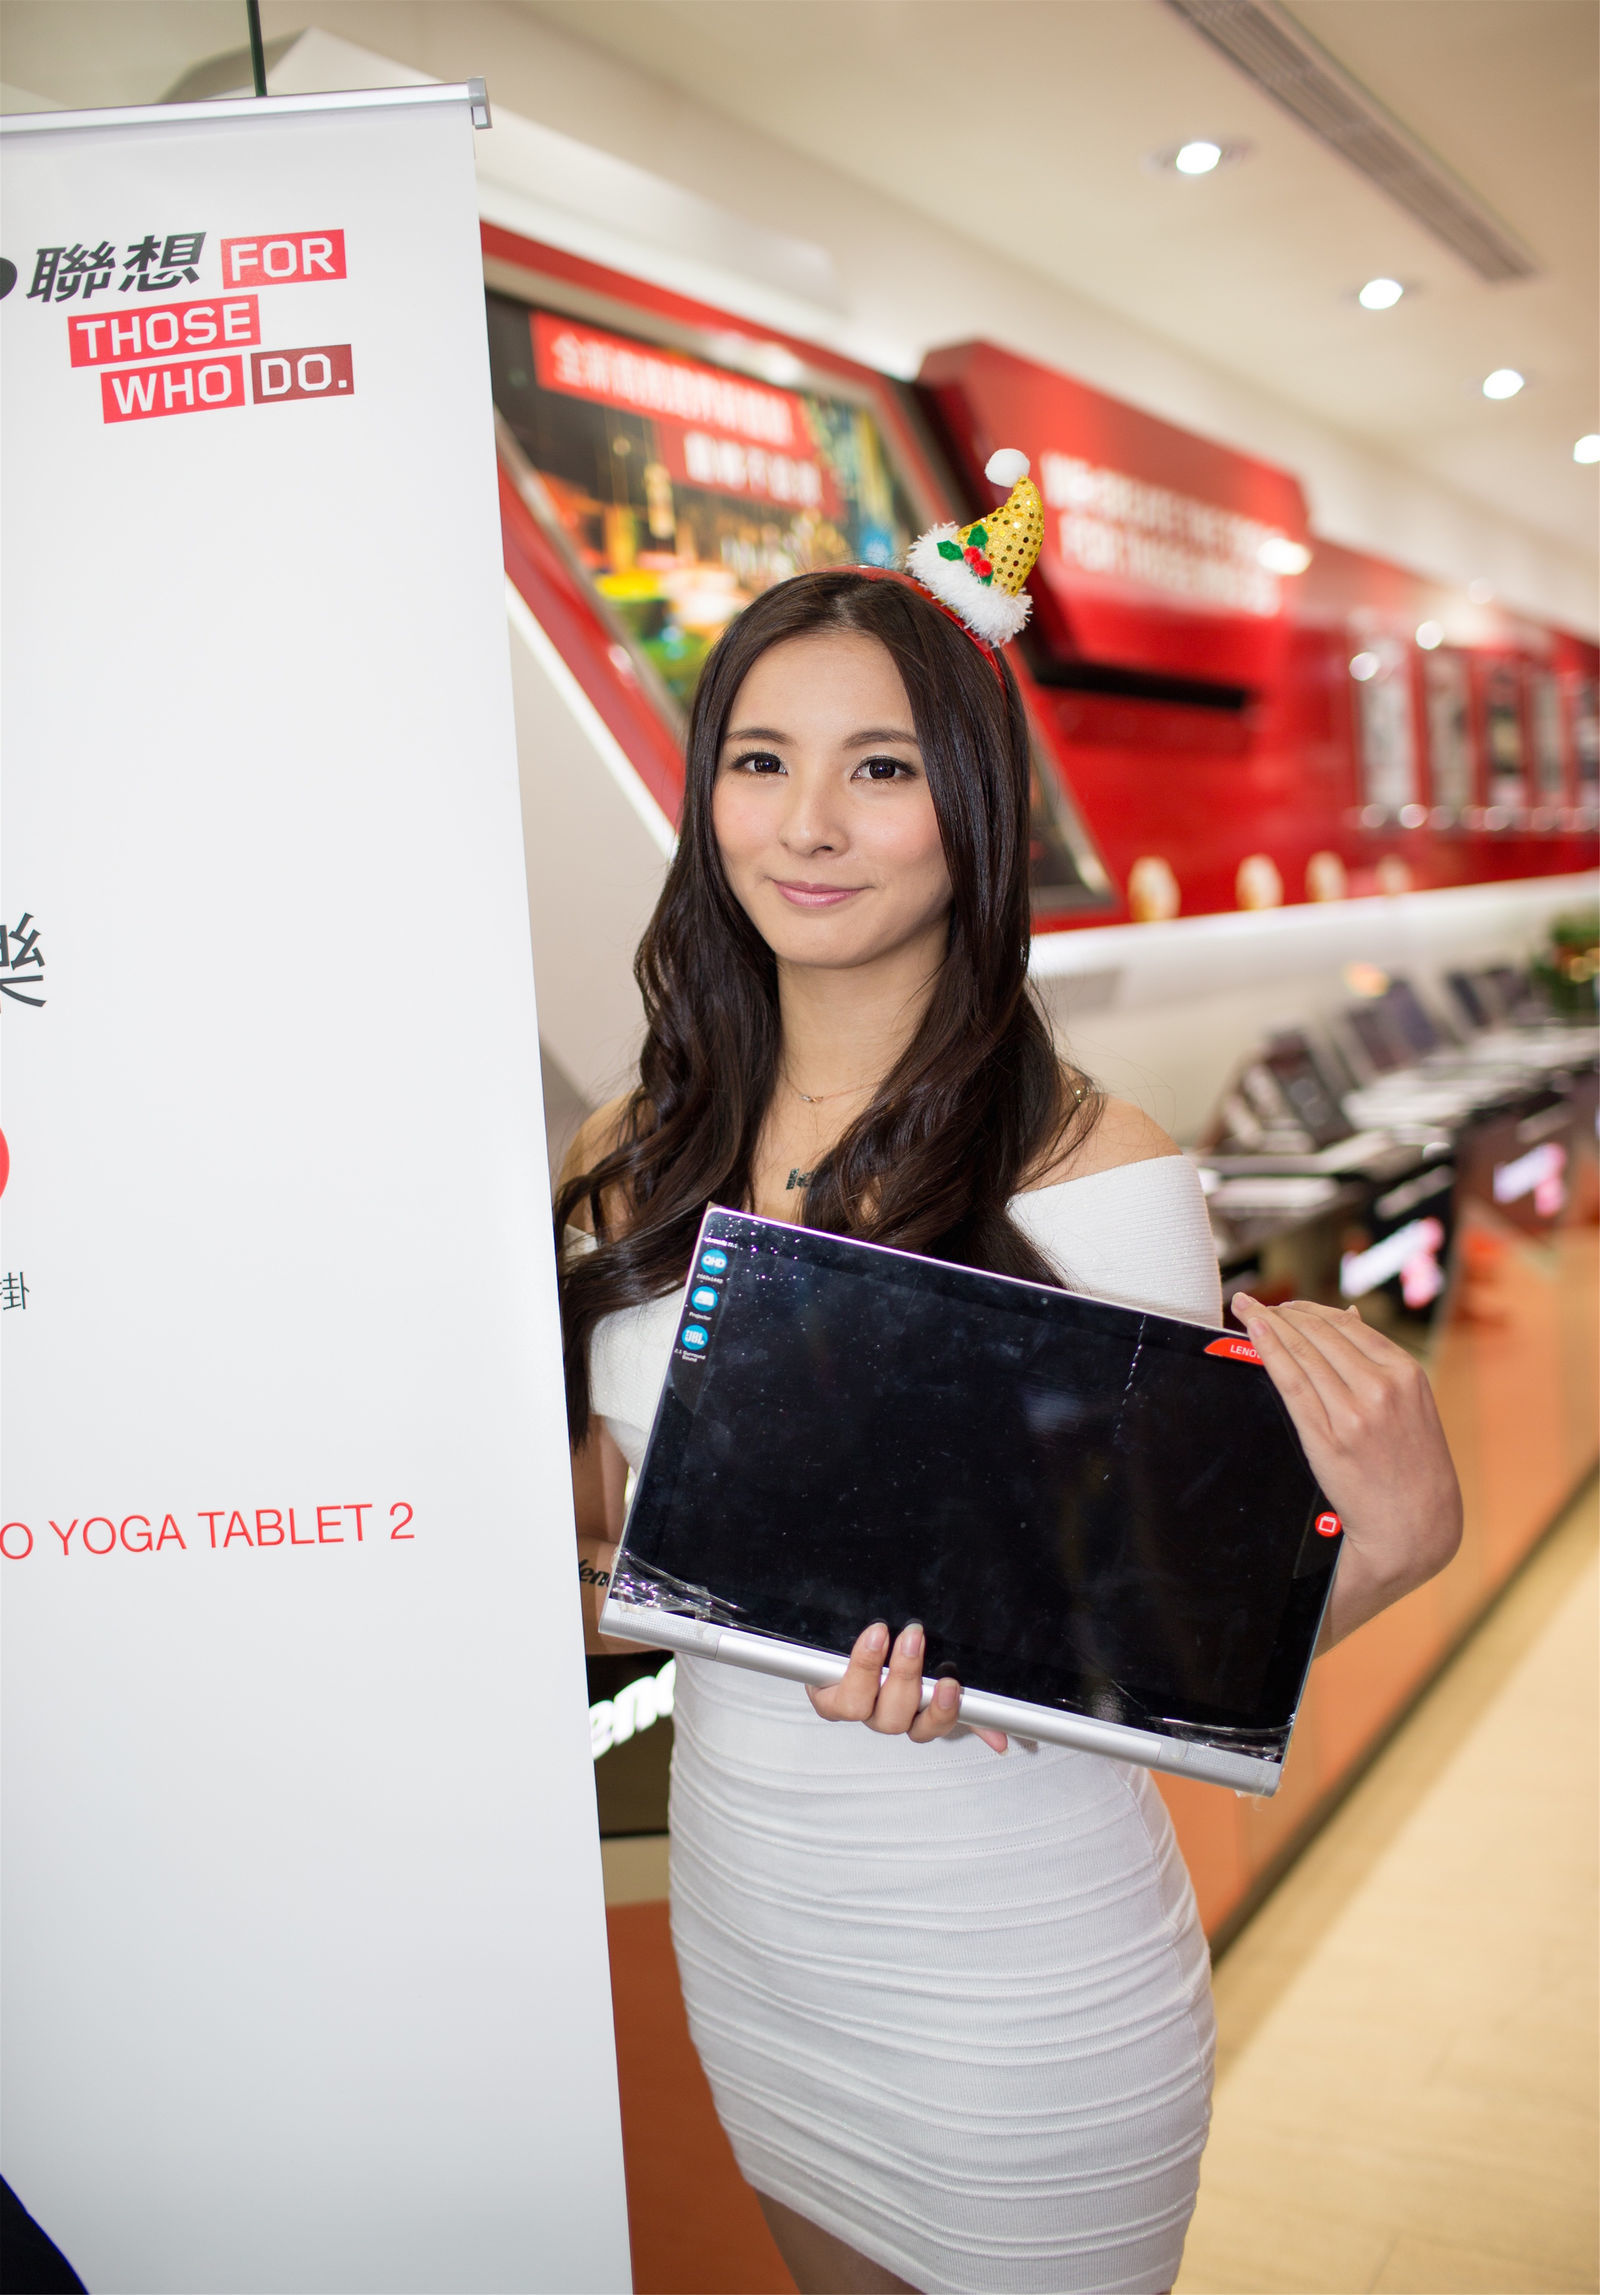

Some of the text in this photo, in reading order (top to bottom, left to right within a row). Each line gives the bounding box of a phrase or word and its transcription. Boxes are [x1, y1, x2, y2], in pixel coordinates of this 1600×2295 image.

[26, 232, 206, 302] 聯想
[230, 237, 337, 282] FOR
[76, 302, 252, 359] THOSE
[111, 353, 348, 415] WHO DO.
[1230, 1344, 1261, 1359] LENO
[48, 1514, 187, 1556] YOGA
[198, 1503, 373, 1549] TABLET
[389, 1502, 416, 1540] 2
